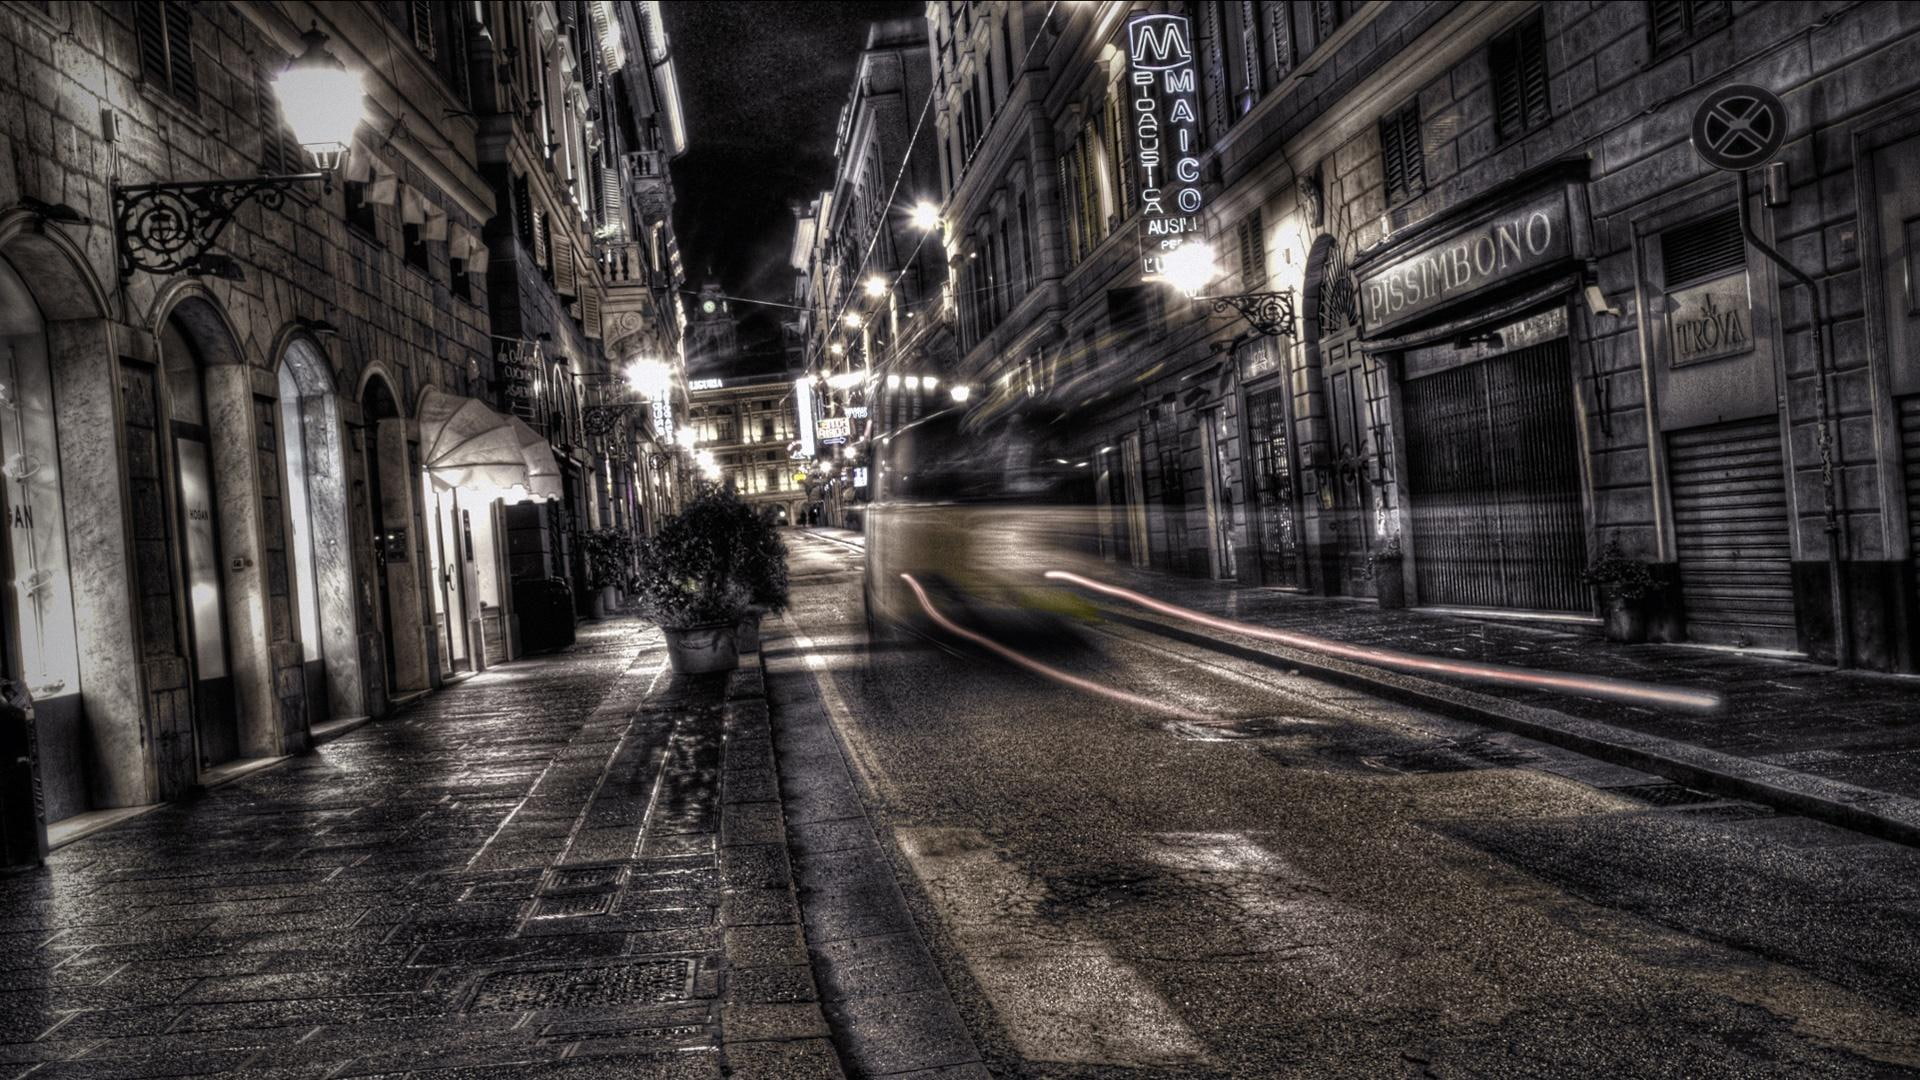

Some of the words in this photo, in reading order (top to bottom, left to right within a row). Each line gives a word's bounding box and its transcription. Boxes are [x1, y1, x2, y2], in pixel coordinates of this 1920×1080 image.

[1133, 71, 1164, 215] BIOACUSTICA
[1164, 69, 1201, 212] MAICO
[1368, 211, 1551, 327] PISSIMBONO
